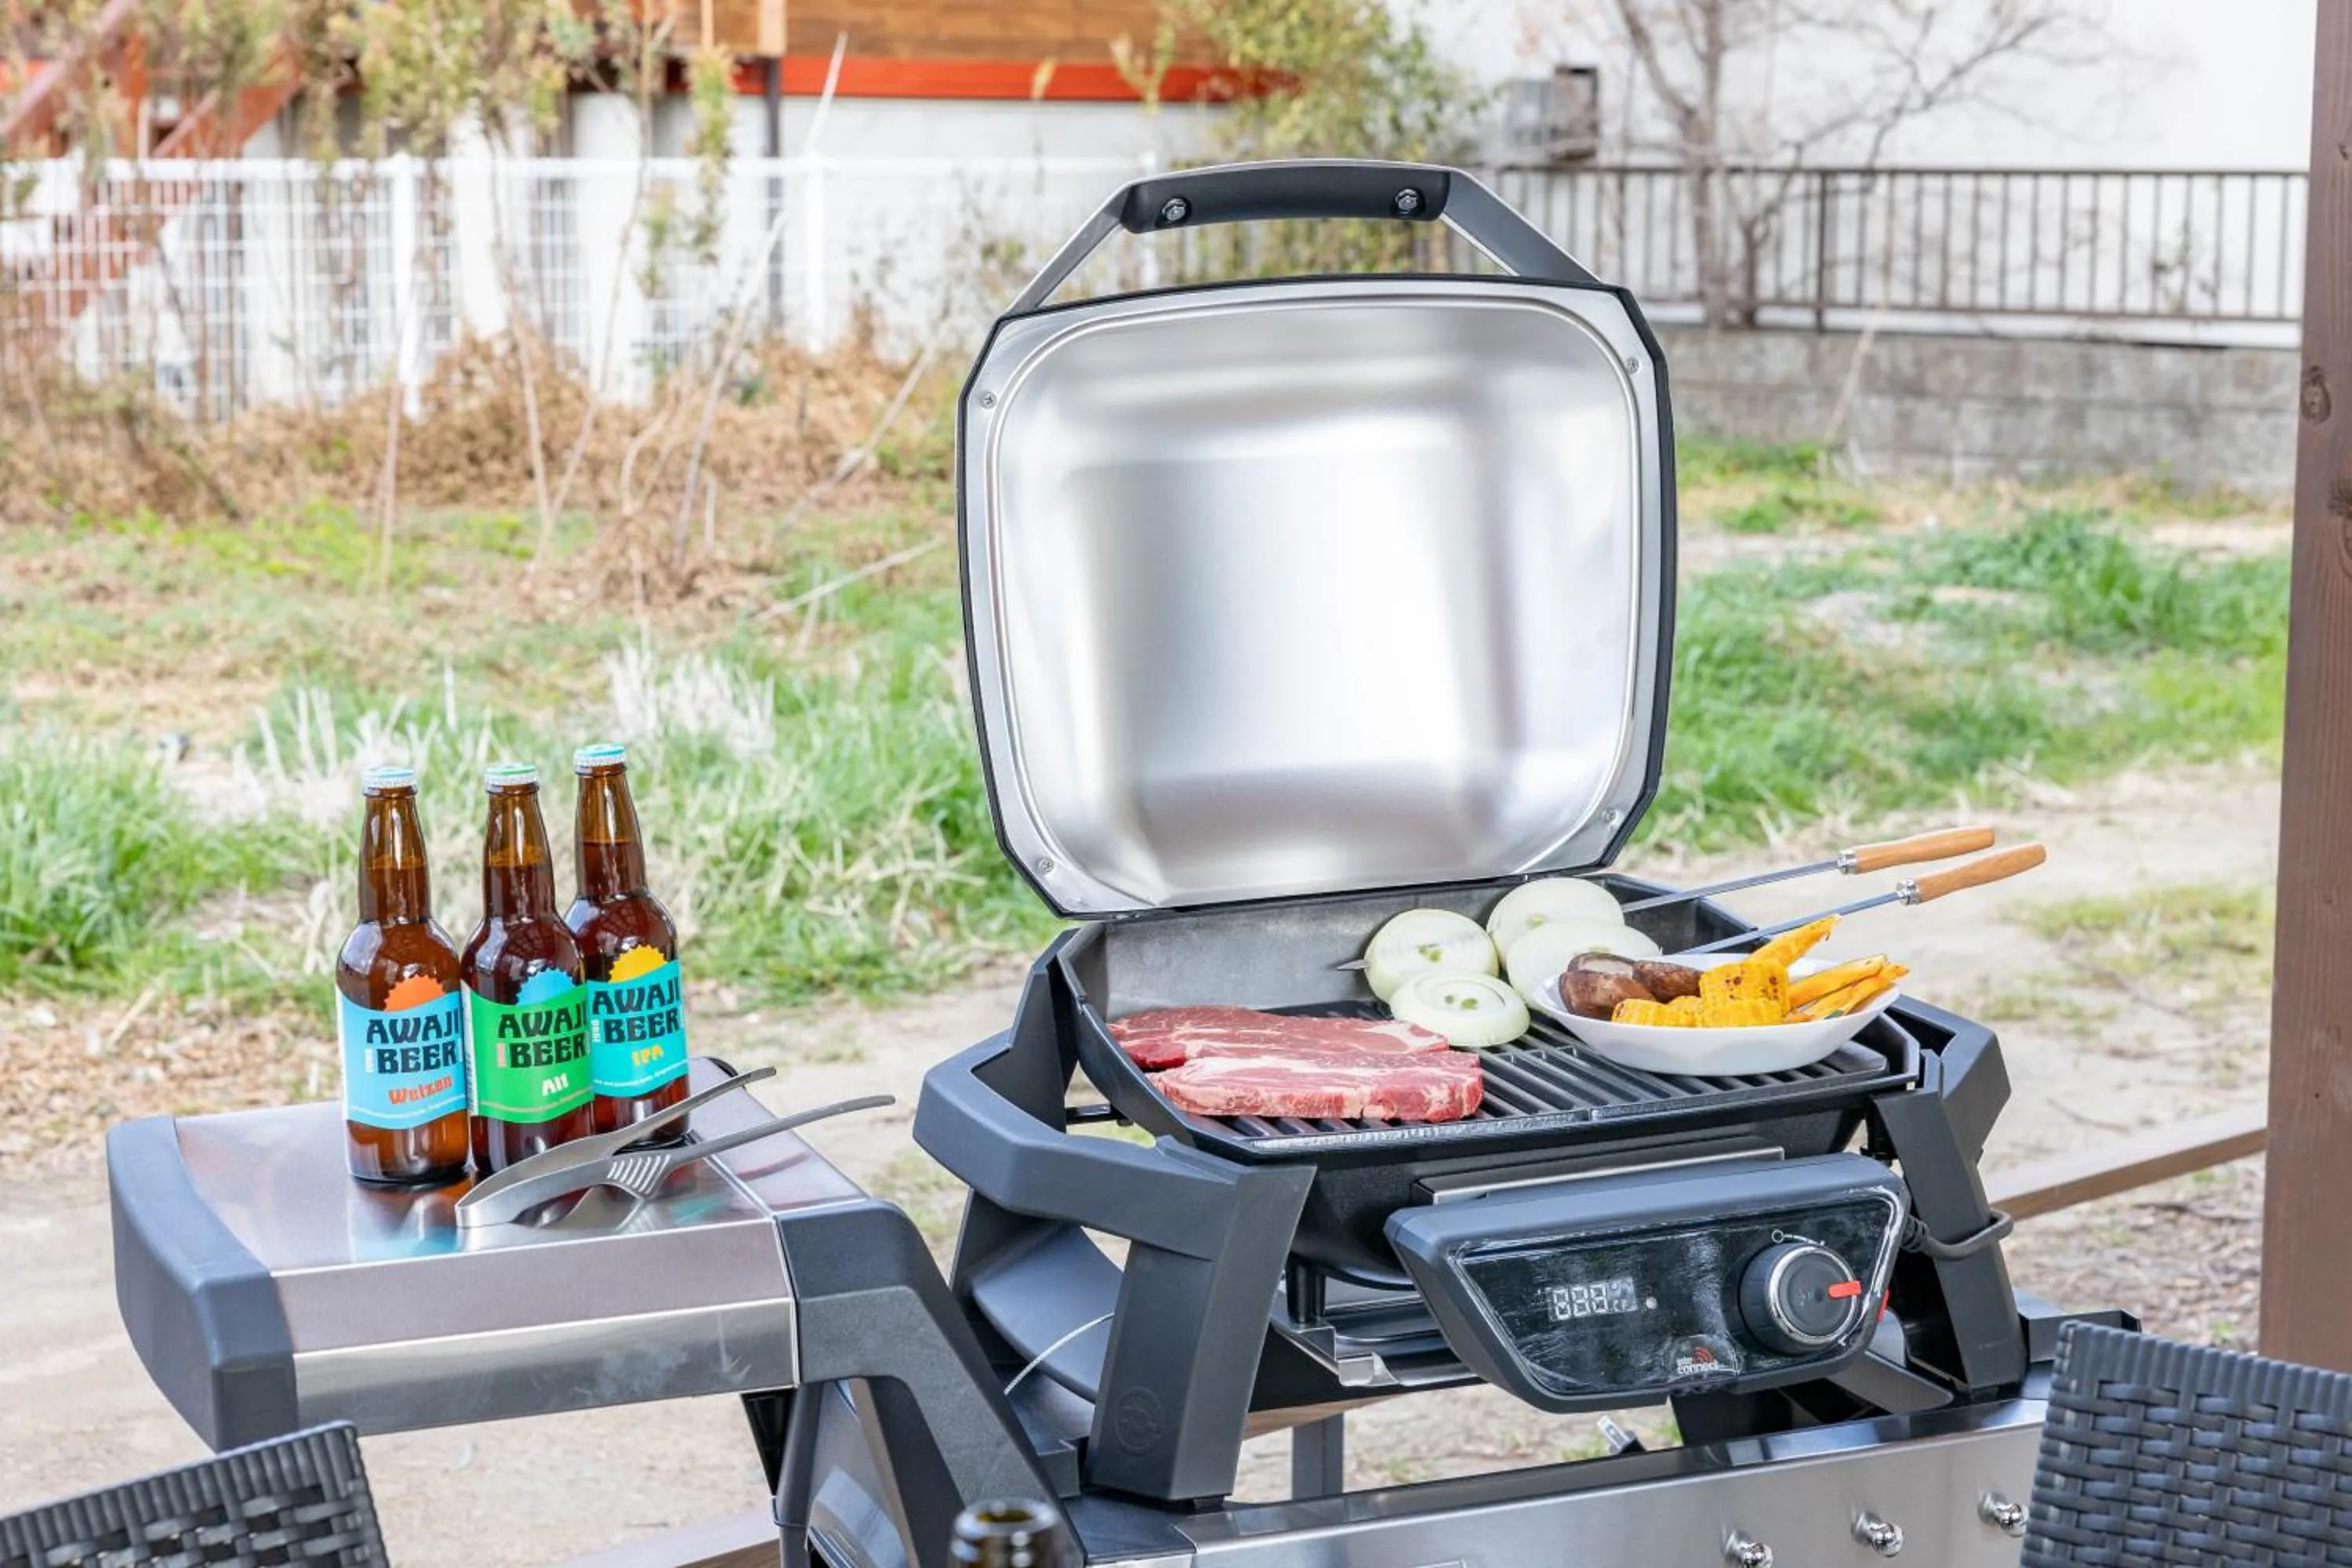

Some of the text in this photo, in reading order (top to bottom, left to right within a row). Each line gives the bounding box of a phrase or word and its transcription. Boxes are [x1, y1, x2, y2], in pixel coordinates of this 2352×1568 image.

[592, 976, 680, 1014] AWAJI
[366, 1009, 459, 1044] AWAJI
[498, 1000, 586, 1038] AWAJI
[604, 1008, 679, 1043] BEER
[377, 1041, 457, 1074] BEER
[510, 1033, 586, 1068] BEER
[631, 1044, 664, 1066] IPA
[388, 1076, 452, 1105] Weizen
